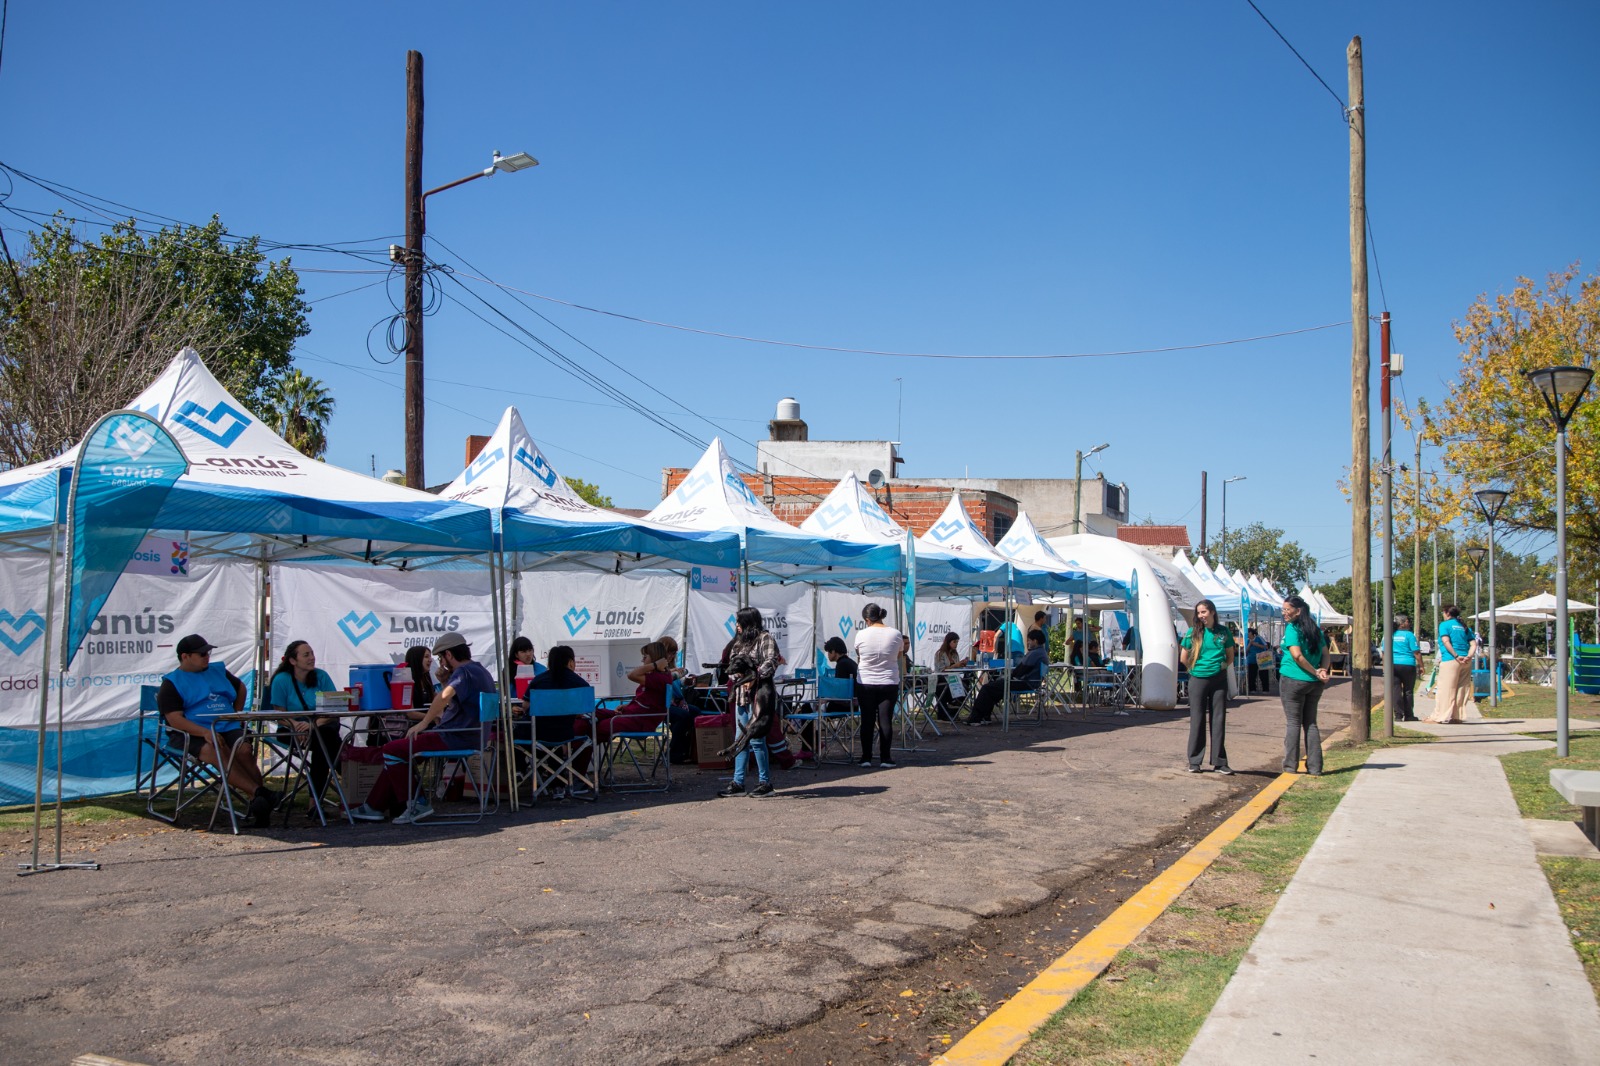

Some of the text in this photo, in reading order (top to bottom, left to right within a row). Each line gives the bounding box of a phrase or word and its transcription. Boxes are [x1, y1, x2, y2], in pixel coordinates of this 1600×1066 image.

[99, 464, 165, 479] Lanús
[219, 468, 287, 478] GOBIERNO
[131, 549, 161, 562] osis
[702, 575, 719, 585] Salud
[89, 606, 175, 636] anús
[389, 610, 460, 633] Lanús
[595, 606, 645, 626] Lanús
[761, 612, 788, 629] anús
[604, 628, 633, 638] GOBIERNO
[928, 621, 951, 634] Lanús
[87, 640, 153, 655] GOBIERNO
[1, 675, 39, 691] dad
[81, 674, 113, 687] nos
[117, 672, 164, 686] merec
